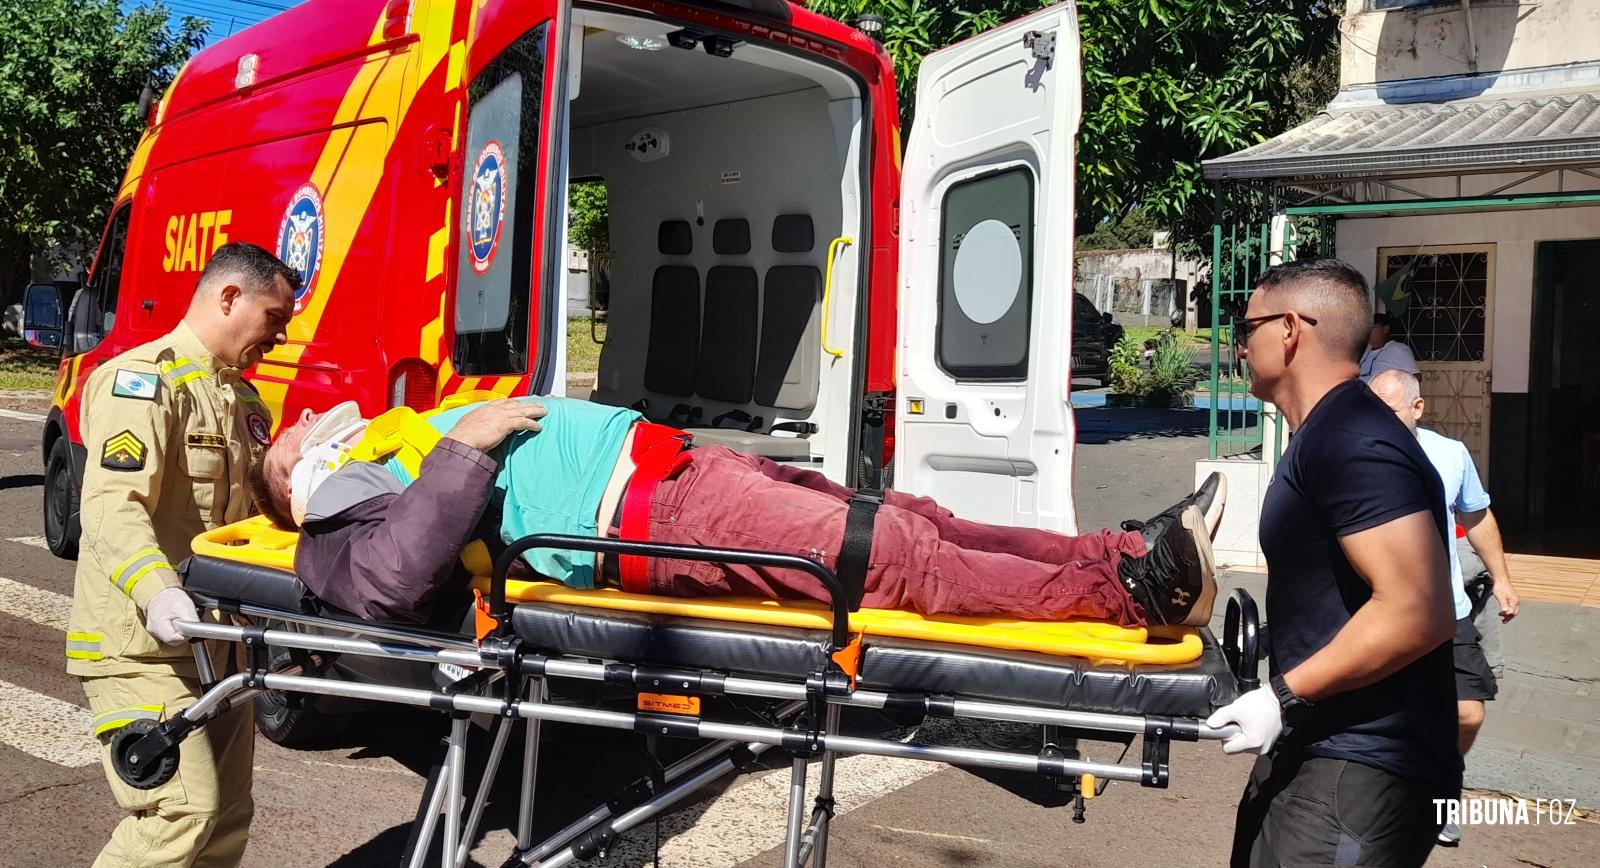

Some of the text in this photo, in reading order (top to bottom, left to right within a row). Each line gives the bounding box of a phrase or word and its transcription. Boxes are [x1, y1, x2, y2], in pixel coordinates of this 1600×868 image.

[163, 209, 233, 272] SIATE
[275, 219, 286, 259] ORPO
[315, 215, 324, 271] MILITAR
[643, 700, 691, 709] SITMED
